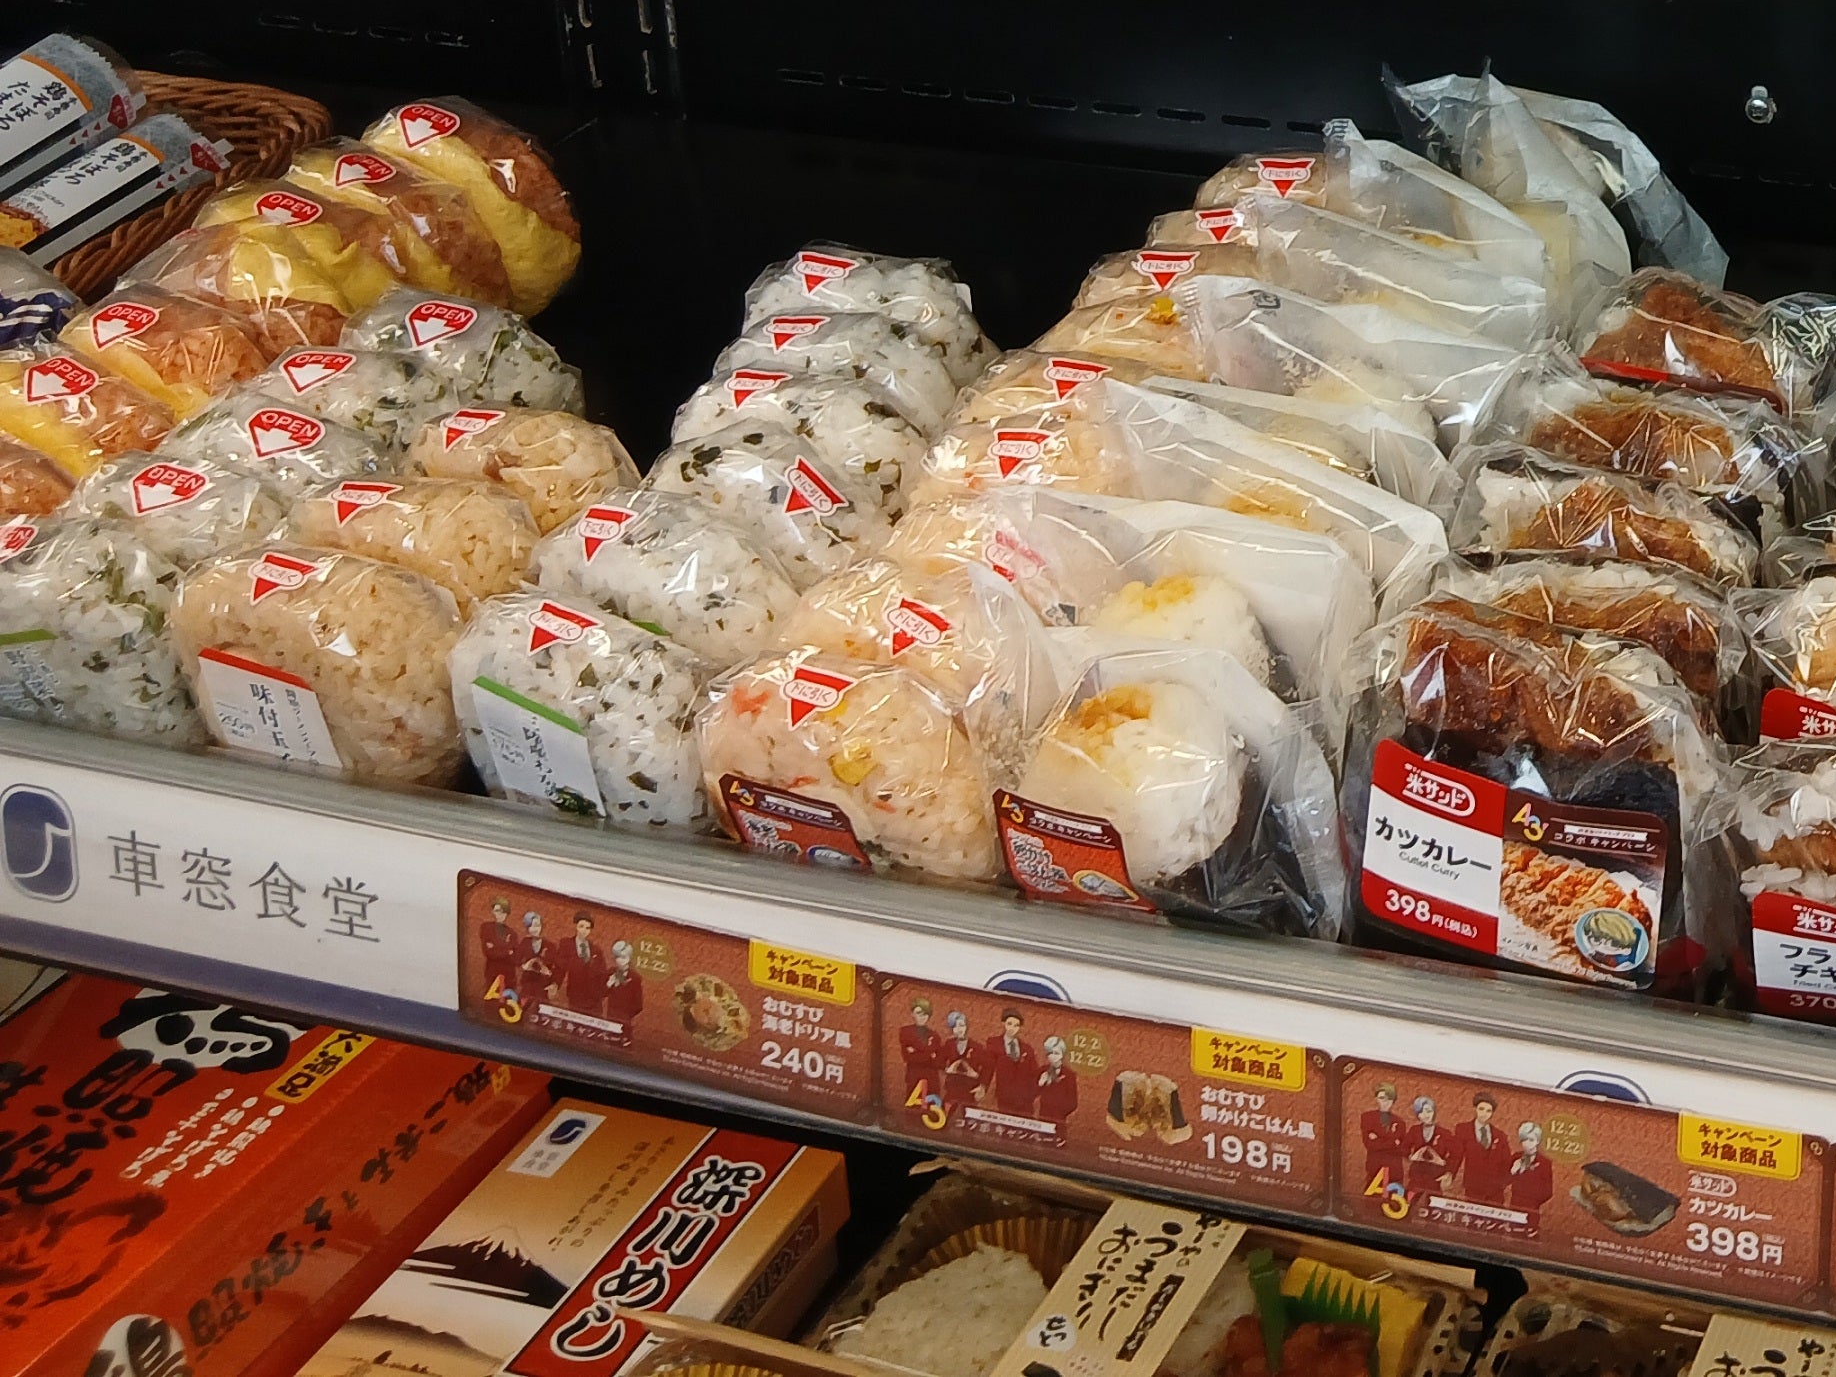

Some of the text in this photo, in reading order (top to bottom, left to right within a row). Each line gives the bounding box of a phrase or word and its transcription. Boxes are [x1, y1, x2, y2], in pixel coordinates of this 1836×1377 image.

[411, 105, 455, 128] OPEN
[268, 193, 316, 215] OPEN
[107, 305, 157, 325] OPEN
[420, 303, 468, 323] OPEN
[48, 356, 91, 386] OPEN
[295, 354, 348, 366] OPEN
[261, 412, 318, 437] OPEN
[148, 467, 204, 491] OPEN
[1405, 772, 1467, 810] 米サンド
[1375, 816, 1493, 871] カツカレー
[107, 830, 382, 944] 車窓食堂
[766, 949, 840, 975] キャンペーン
[768, 964, 836, 995] 対象商品
[762, 995, 825, 1024] おむすび
[761, 1013, 852, 1050] 海老ドリア風
[760, 1040, 845, 1086] 240円
[1209, 1036, 1289, 1061] キャンペーン
[1212, 1053, 1284, 1082] 対象商品
[1200, 1084, 1265, 1111] おむすび
[1200, 1103, 1317, 1142] 卵かけごはん風
[1697, 1121, 1784, 1150] キャンペーン
[1201, 1131, 1293, 1175] 198円
[1700, 1140, 1778, 1171] 対象商品
[1418, 1207, 1457, 1224] コラボ
[1461, 1213, 1539, 1238] キャンペーン
[1688, 1196, 1774, 1223] カツカレー
[551, 1156, 766, 1360] 深川めし
[1686, 1221, 1784, 1266] 398円
[1075, 1222, 1139, 1331] おにぎり
[1098, 1221, 1185, 1342] うまだし
